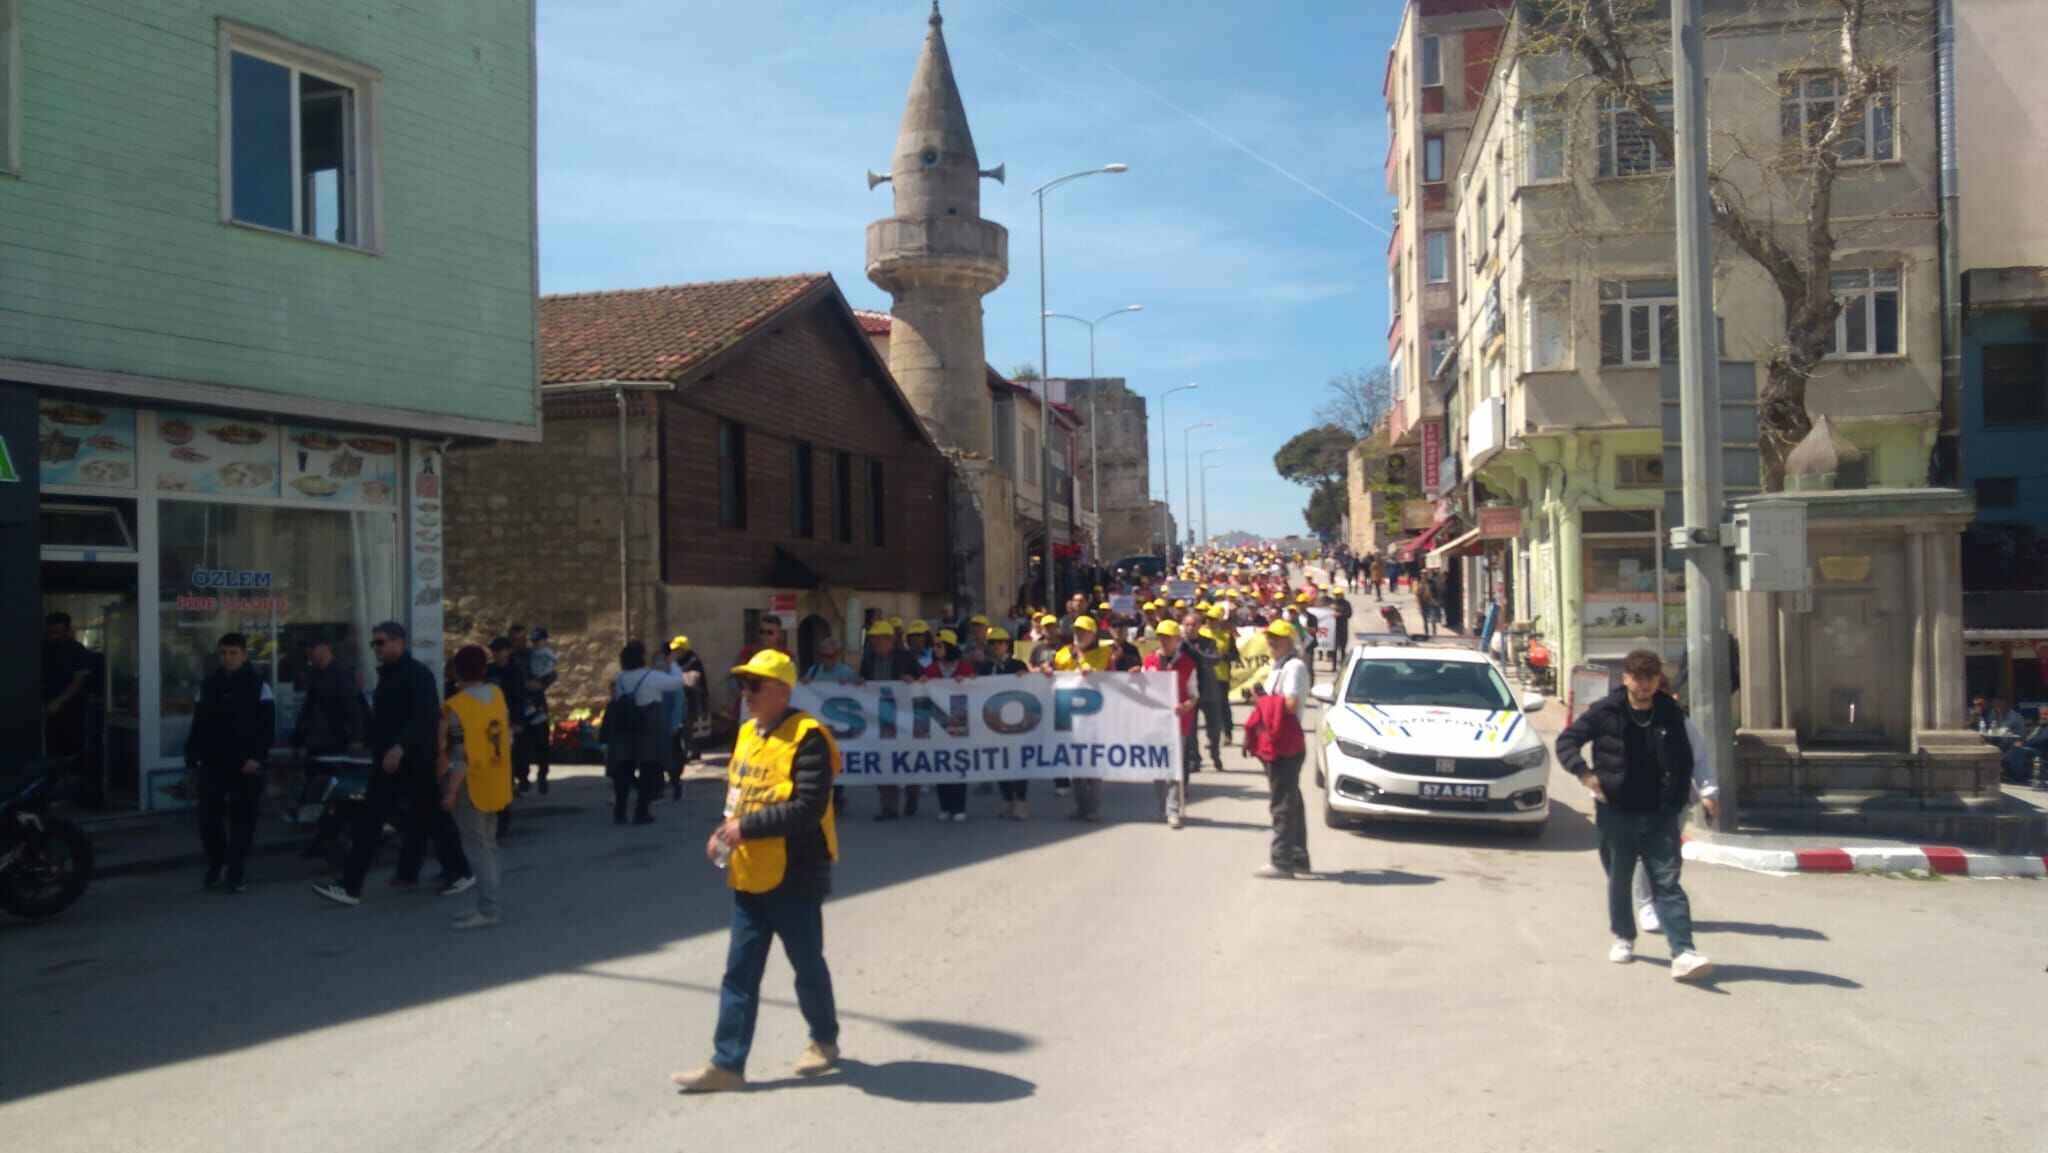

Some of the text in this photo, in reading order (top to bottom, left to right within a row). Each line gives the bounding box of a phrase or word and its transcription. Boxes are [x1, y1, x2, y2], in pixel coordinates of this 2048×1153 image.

[192, 564, 273, 588] ÖZLEM
[1235, 655, 1270, 669] AYIR
[820, 685, 1105, 740] SİNOP
[892, 747, 1009, 778] KARŞITI
[1021, 743, 1170, 769] PLATFORM
[1442, 784, 1453, 797] A
